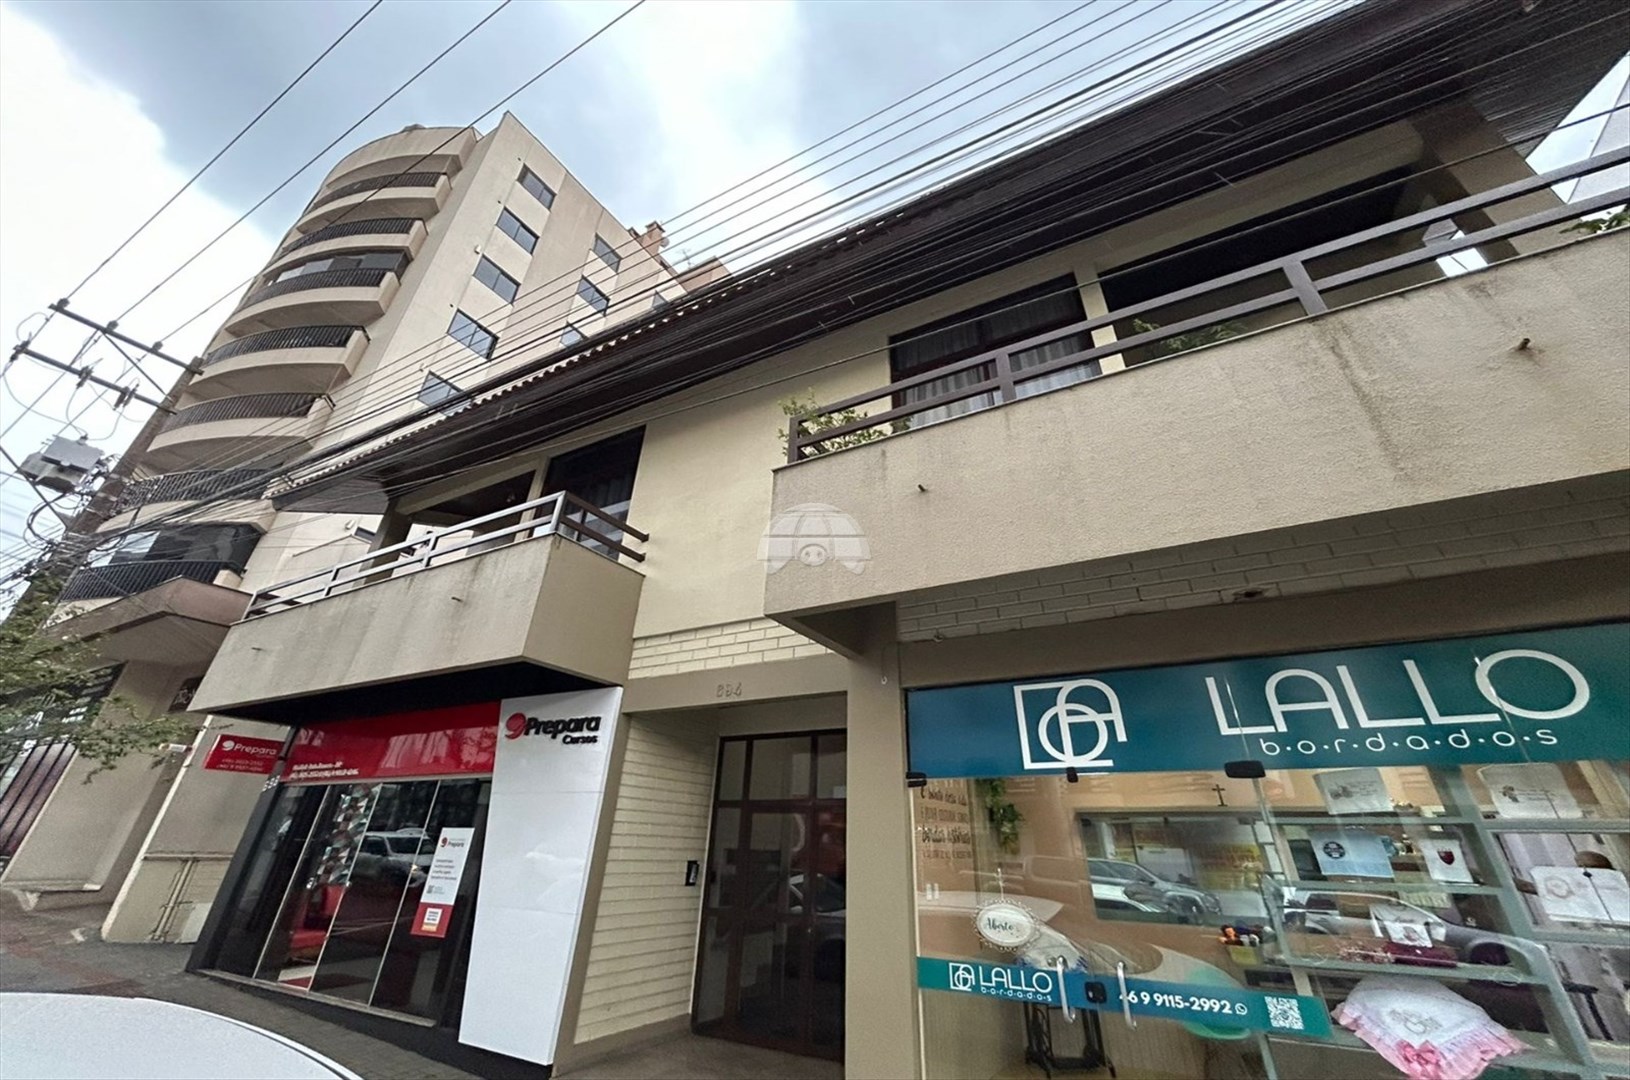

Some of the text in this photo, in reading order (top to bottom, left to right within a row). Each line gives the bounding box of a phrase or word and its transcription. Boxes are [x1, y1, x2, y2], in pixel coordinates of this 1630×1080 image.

[1204, 648, 1590, 736] LALLO
[523, 716, 602, 739] Prepara
[233, 743, 277, 755] Prepara
[562, 734, 598, 745] Cursos
[978, 965, 1053, 993] LALLO
[1140, 991, 1151, 1005] 9
[1153, 992, 1233, 1015] 9115-2992
